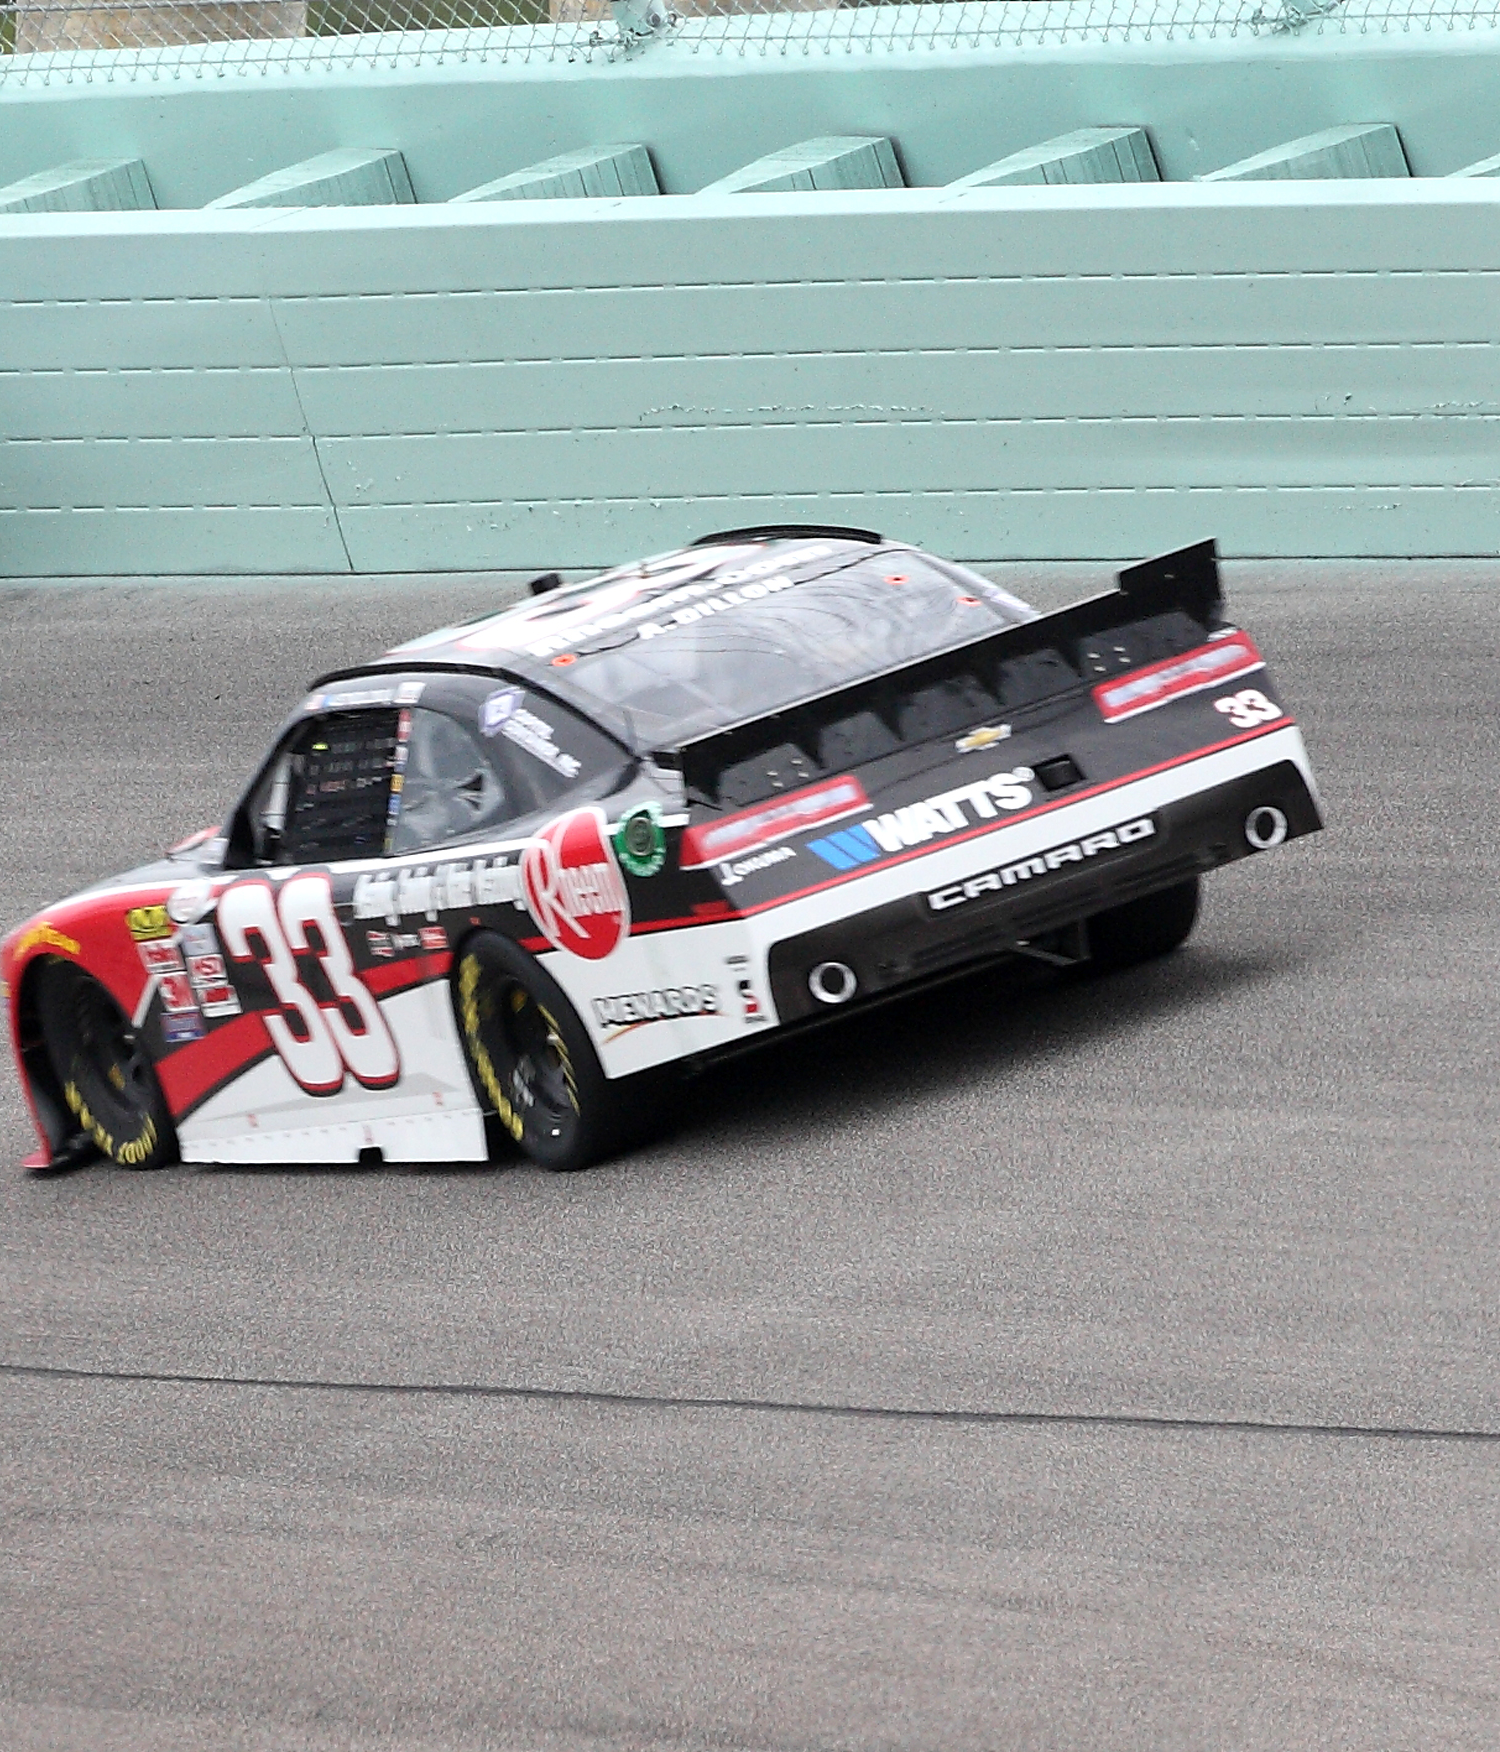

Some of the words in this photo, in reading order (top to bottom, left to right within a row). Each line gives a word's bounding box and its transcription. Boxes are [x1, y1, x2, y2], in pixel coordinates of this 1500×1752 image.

[671, 575, 795, 625] DILLON
[1213, 688, 1284, 729] 33
[862, 771, 1034, 852] WATTS
[927, 816, 1156, 911] CAMARO
[216, 870, 401, 1097] 33
[593, 984, 717, 1028] MENARDS
